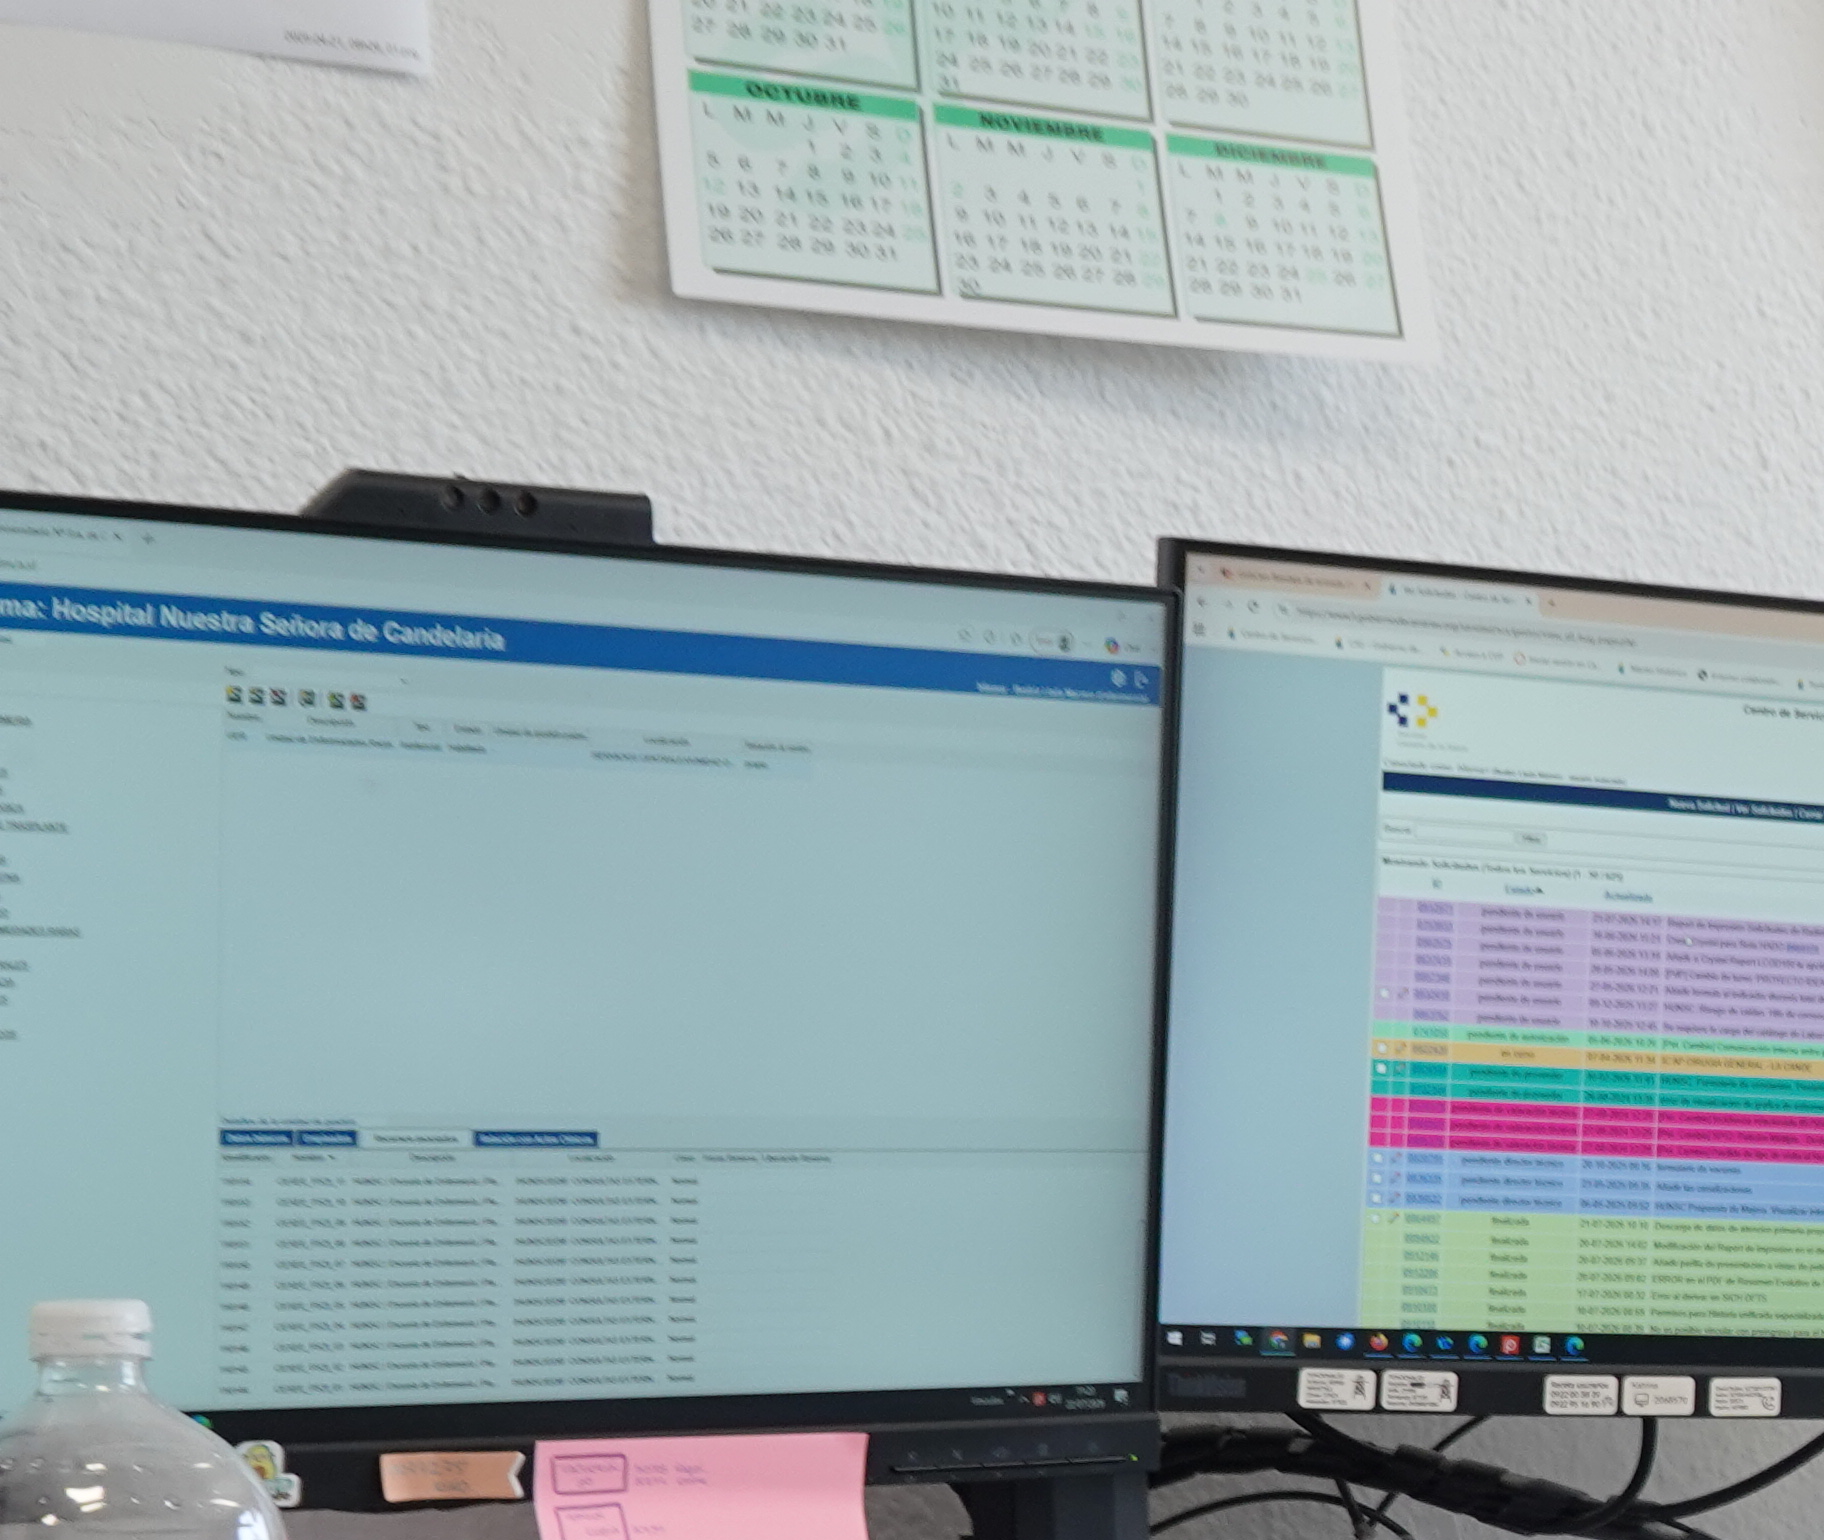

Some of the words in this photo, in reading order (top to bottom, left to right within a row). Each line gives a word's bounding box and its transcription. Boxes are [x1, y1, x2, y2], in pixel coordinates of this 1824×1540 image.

[746, 80, 861, 109] OCTUBRE
[979, 111, 1105, 142] NOVIEMBRE
[52, 598, 153, 628] Hospital
[160, 606, 255, 634] Nuestra
[259, 610, 343, 640] Señora
[349, 618, 378, 643] de
[383, 619, 506, 652] Candelaria
[1744, 704, 1777, 717] Centro
[1778, 707, 1791, 718] de
